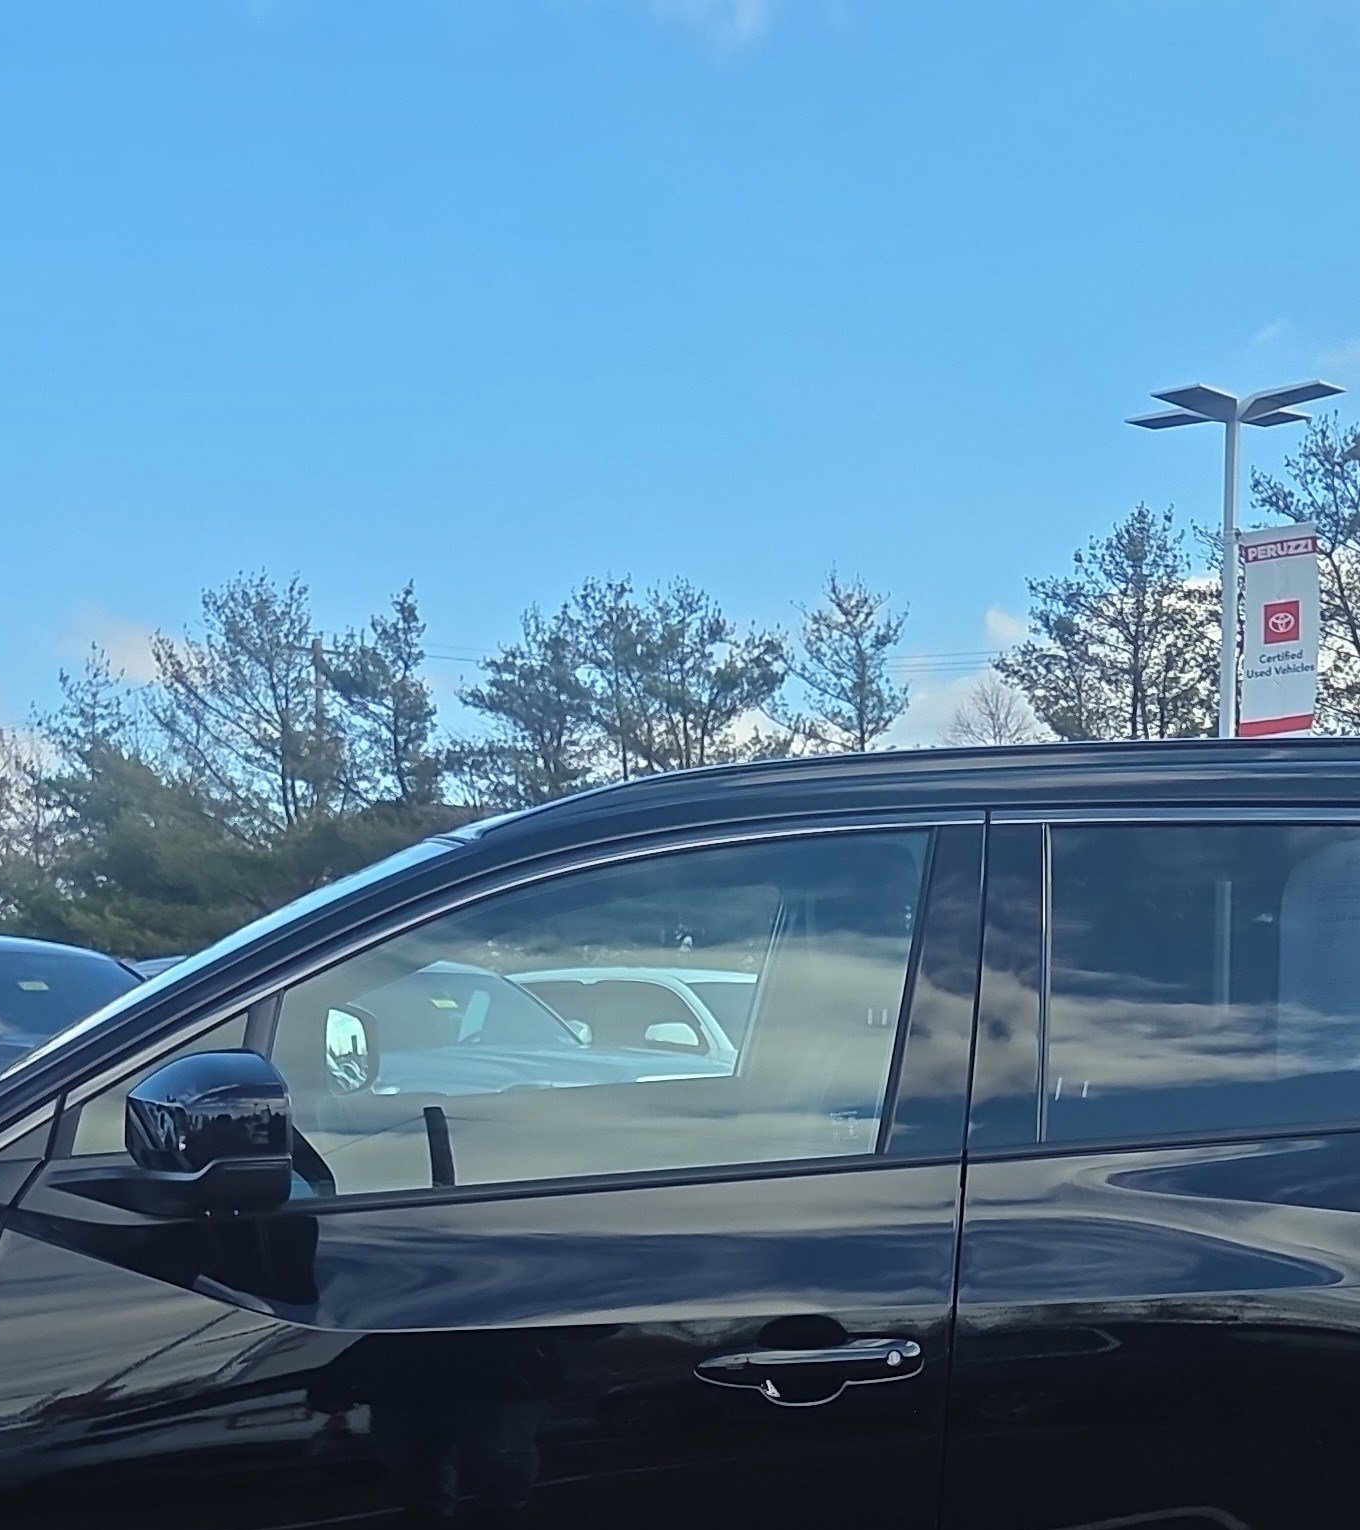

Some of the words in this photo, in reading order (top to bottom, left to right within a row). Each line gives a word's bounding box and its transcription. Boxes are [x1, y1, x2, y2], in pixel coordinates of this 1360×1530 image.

[1247, 539, 1313, 562] PERUZZI
[1258, 649, 1304, 665] Certified
[1246, 666, 1272, 680] Used
[1273, 662, 1316, 677] Vehicles
